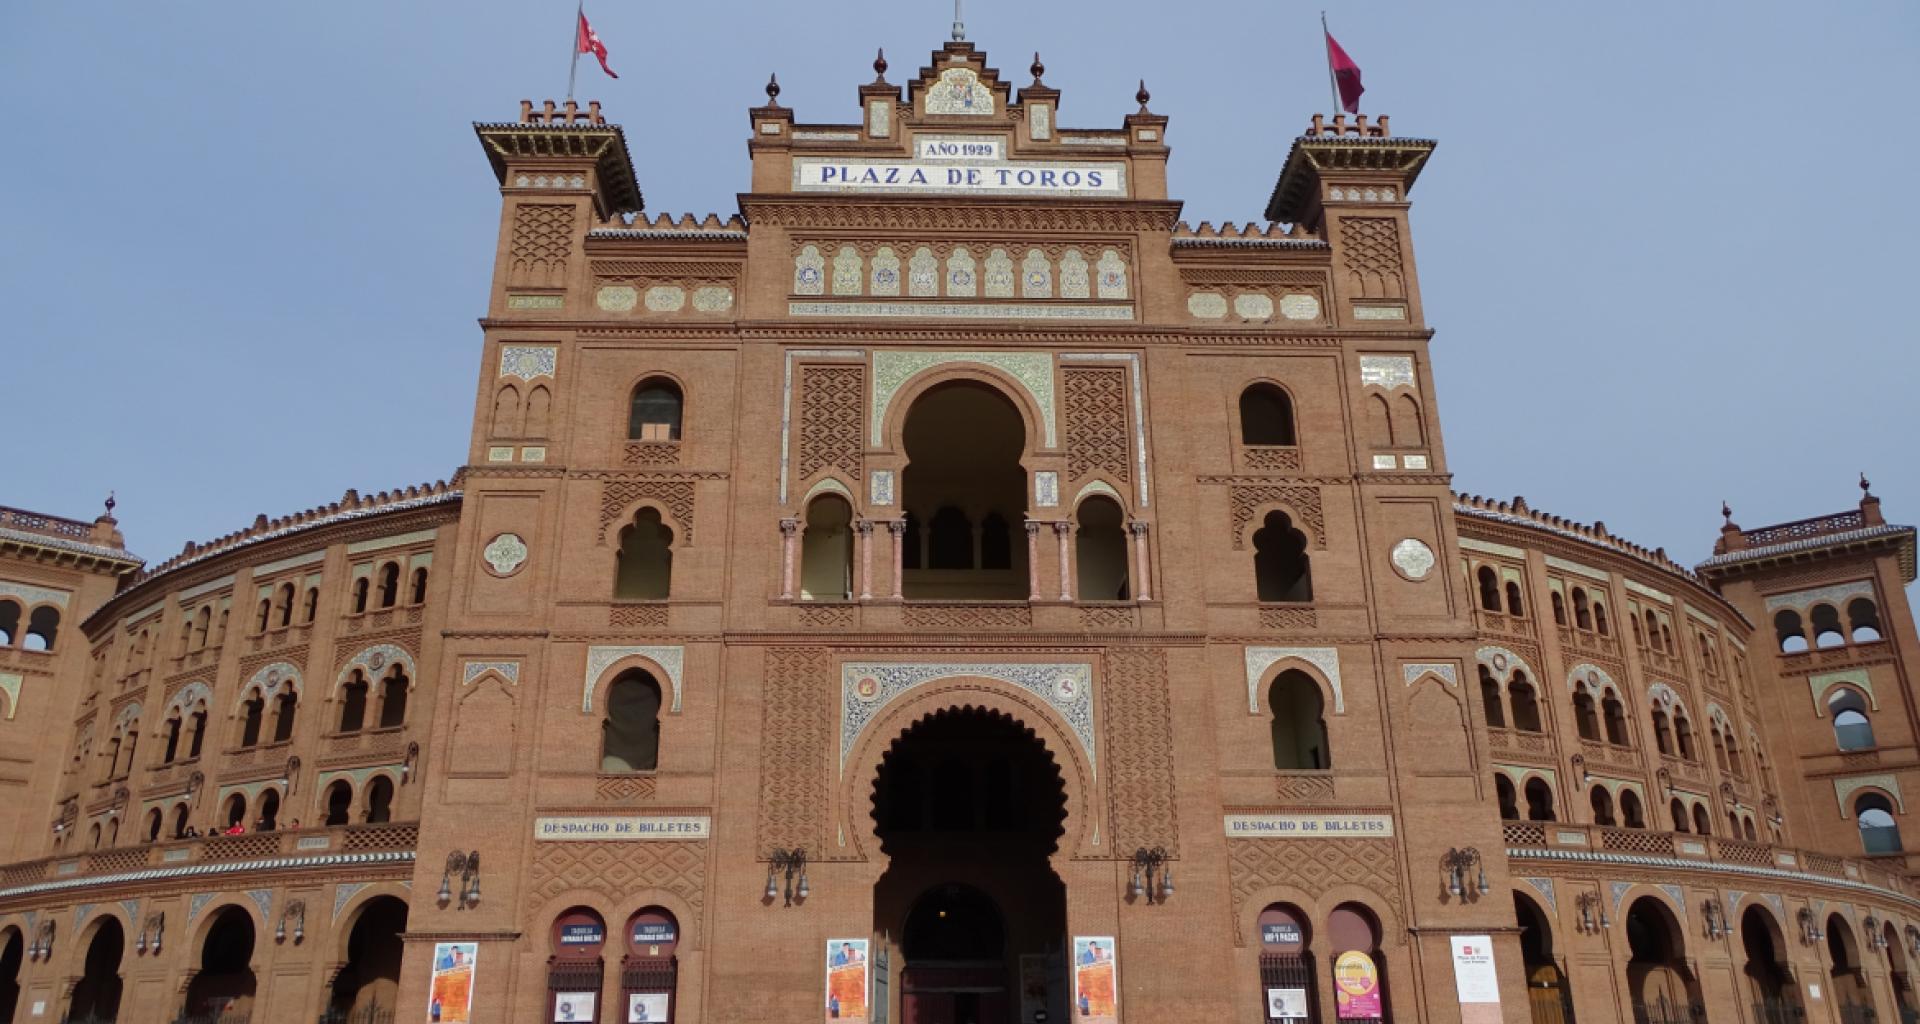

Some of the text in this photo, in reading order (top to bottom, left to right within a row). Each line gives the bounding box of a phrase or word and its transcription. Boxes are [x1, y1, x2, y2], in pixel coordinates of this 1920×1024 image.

[926, 141, 993, 156] AÑO 1929
[820, 165, 1103, 187] PLAZA DE TOROS
[544, 822, 701, 834] DESPACHO DE BILLETES
[1232, 820, 1385, 831] DESPACHO DE BILLETES
